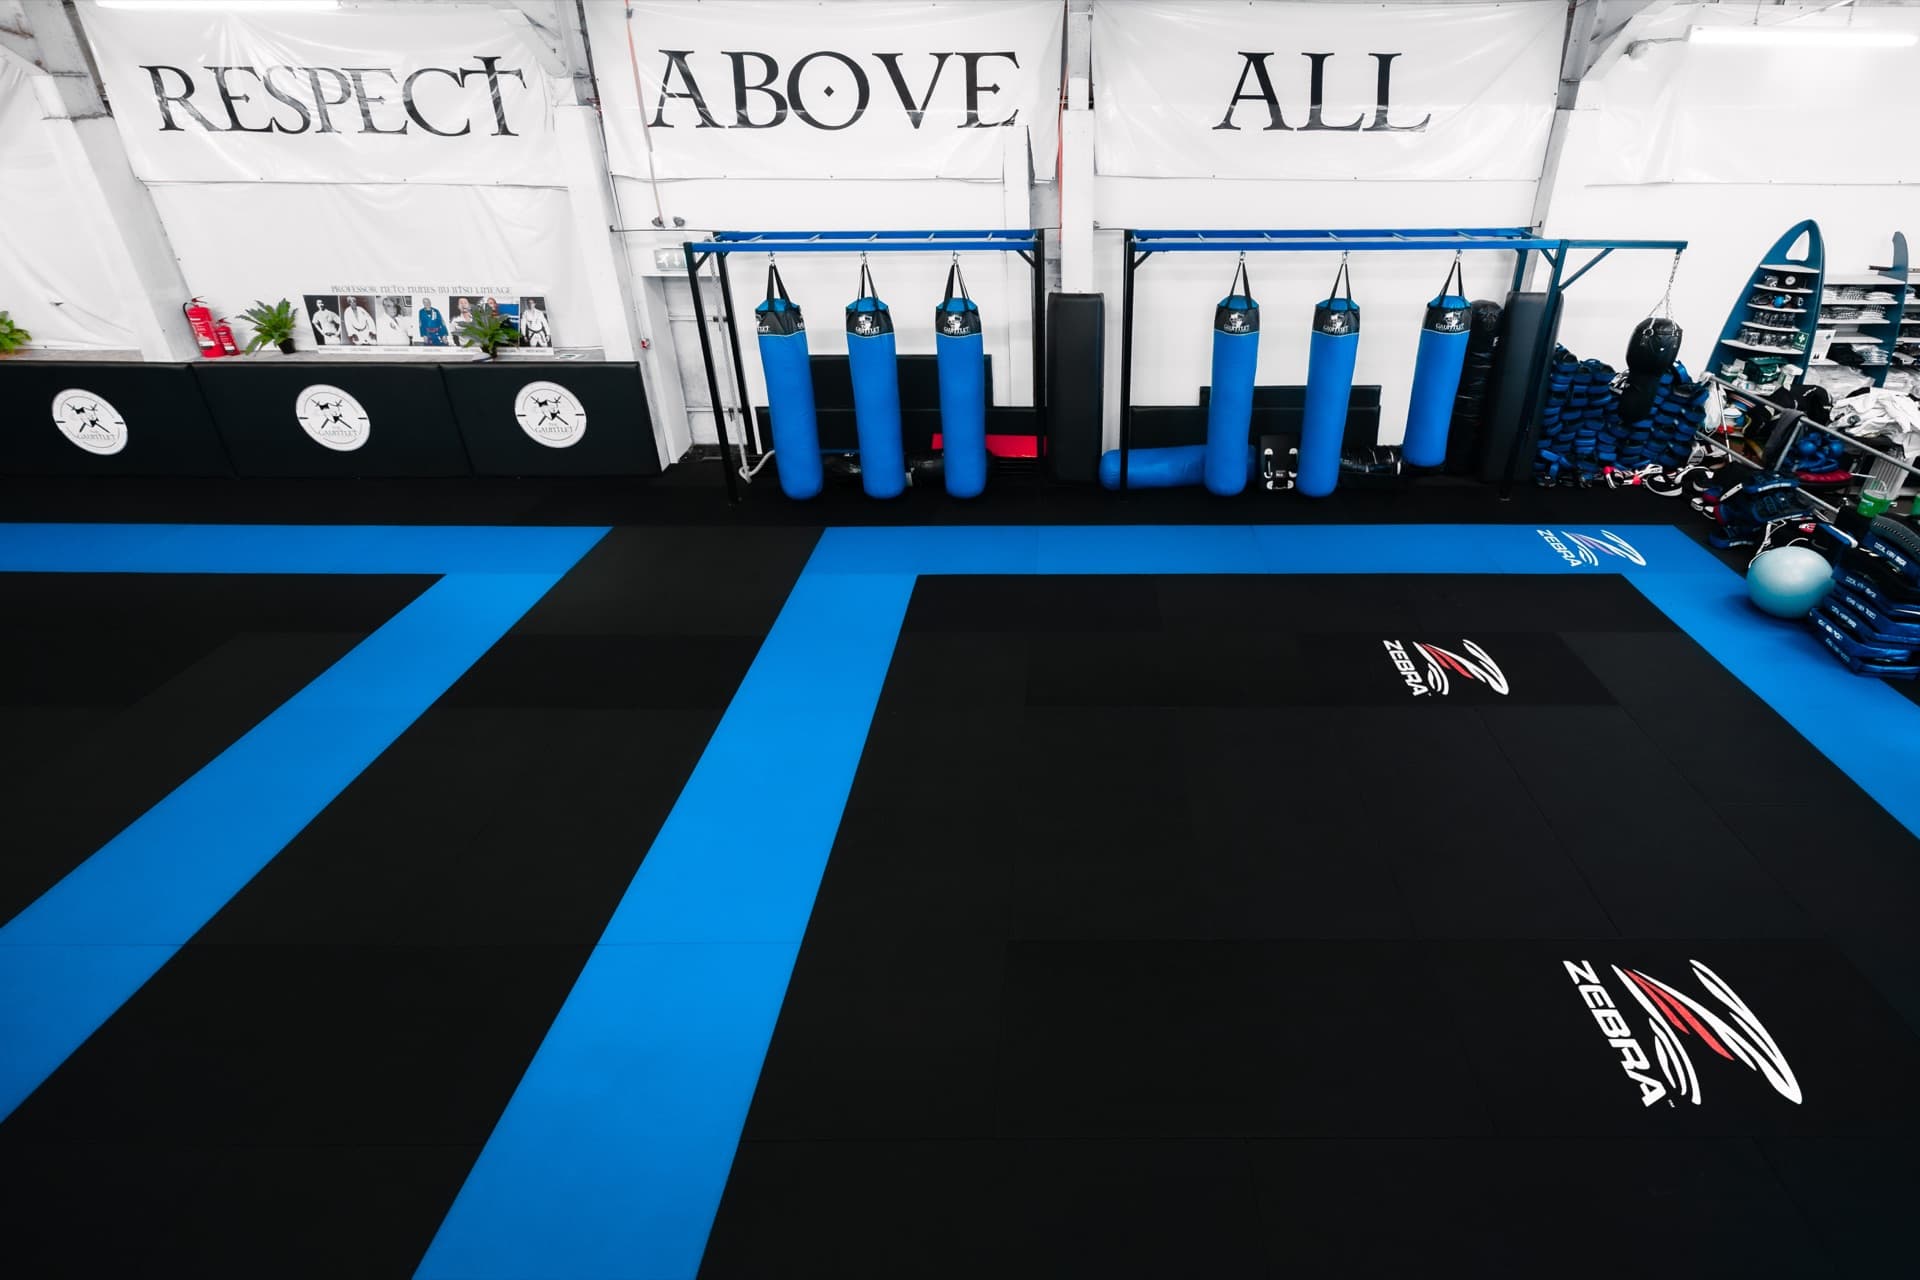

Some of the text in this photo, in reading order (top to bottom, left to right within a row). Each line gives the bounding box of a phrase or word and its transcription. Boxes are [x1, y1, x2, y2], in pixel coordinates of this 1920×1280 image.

[139, 55, 527, 137] RESPECT
[646, 48, 1020, 130] ABOVE
[1212, 51, 1431, 132] ALL
[1536, 529, 1583, 567] ZEBRA
[1383, 639, 1429, 697] ZEBRA
[1563, 960, 1667, 1108] ZEBRA
